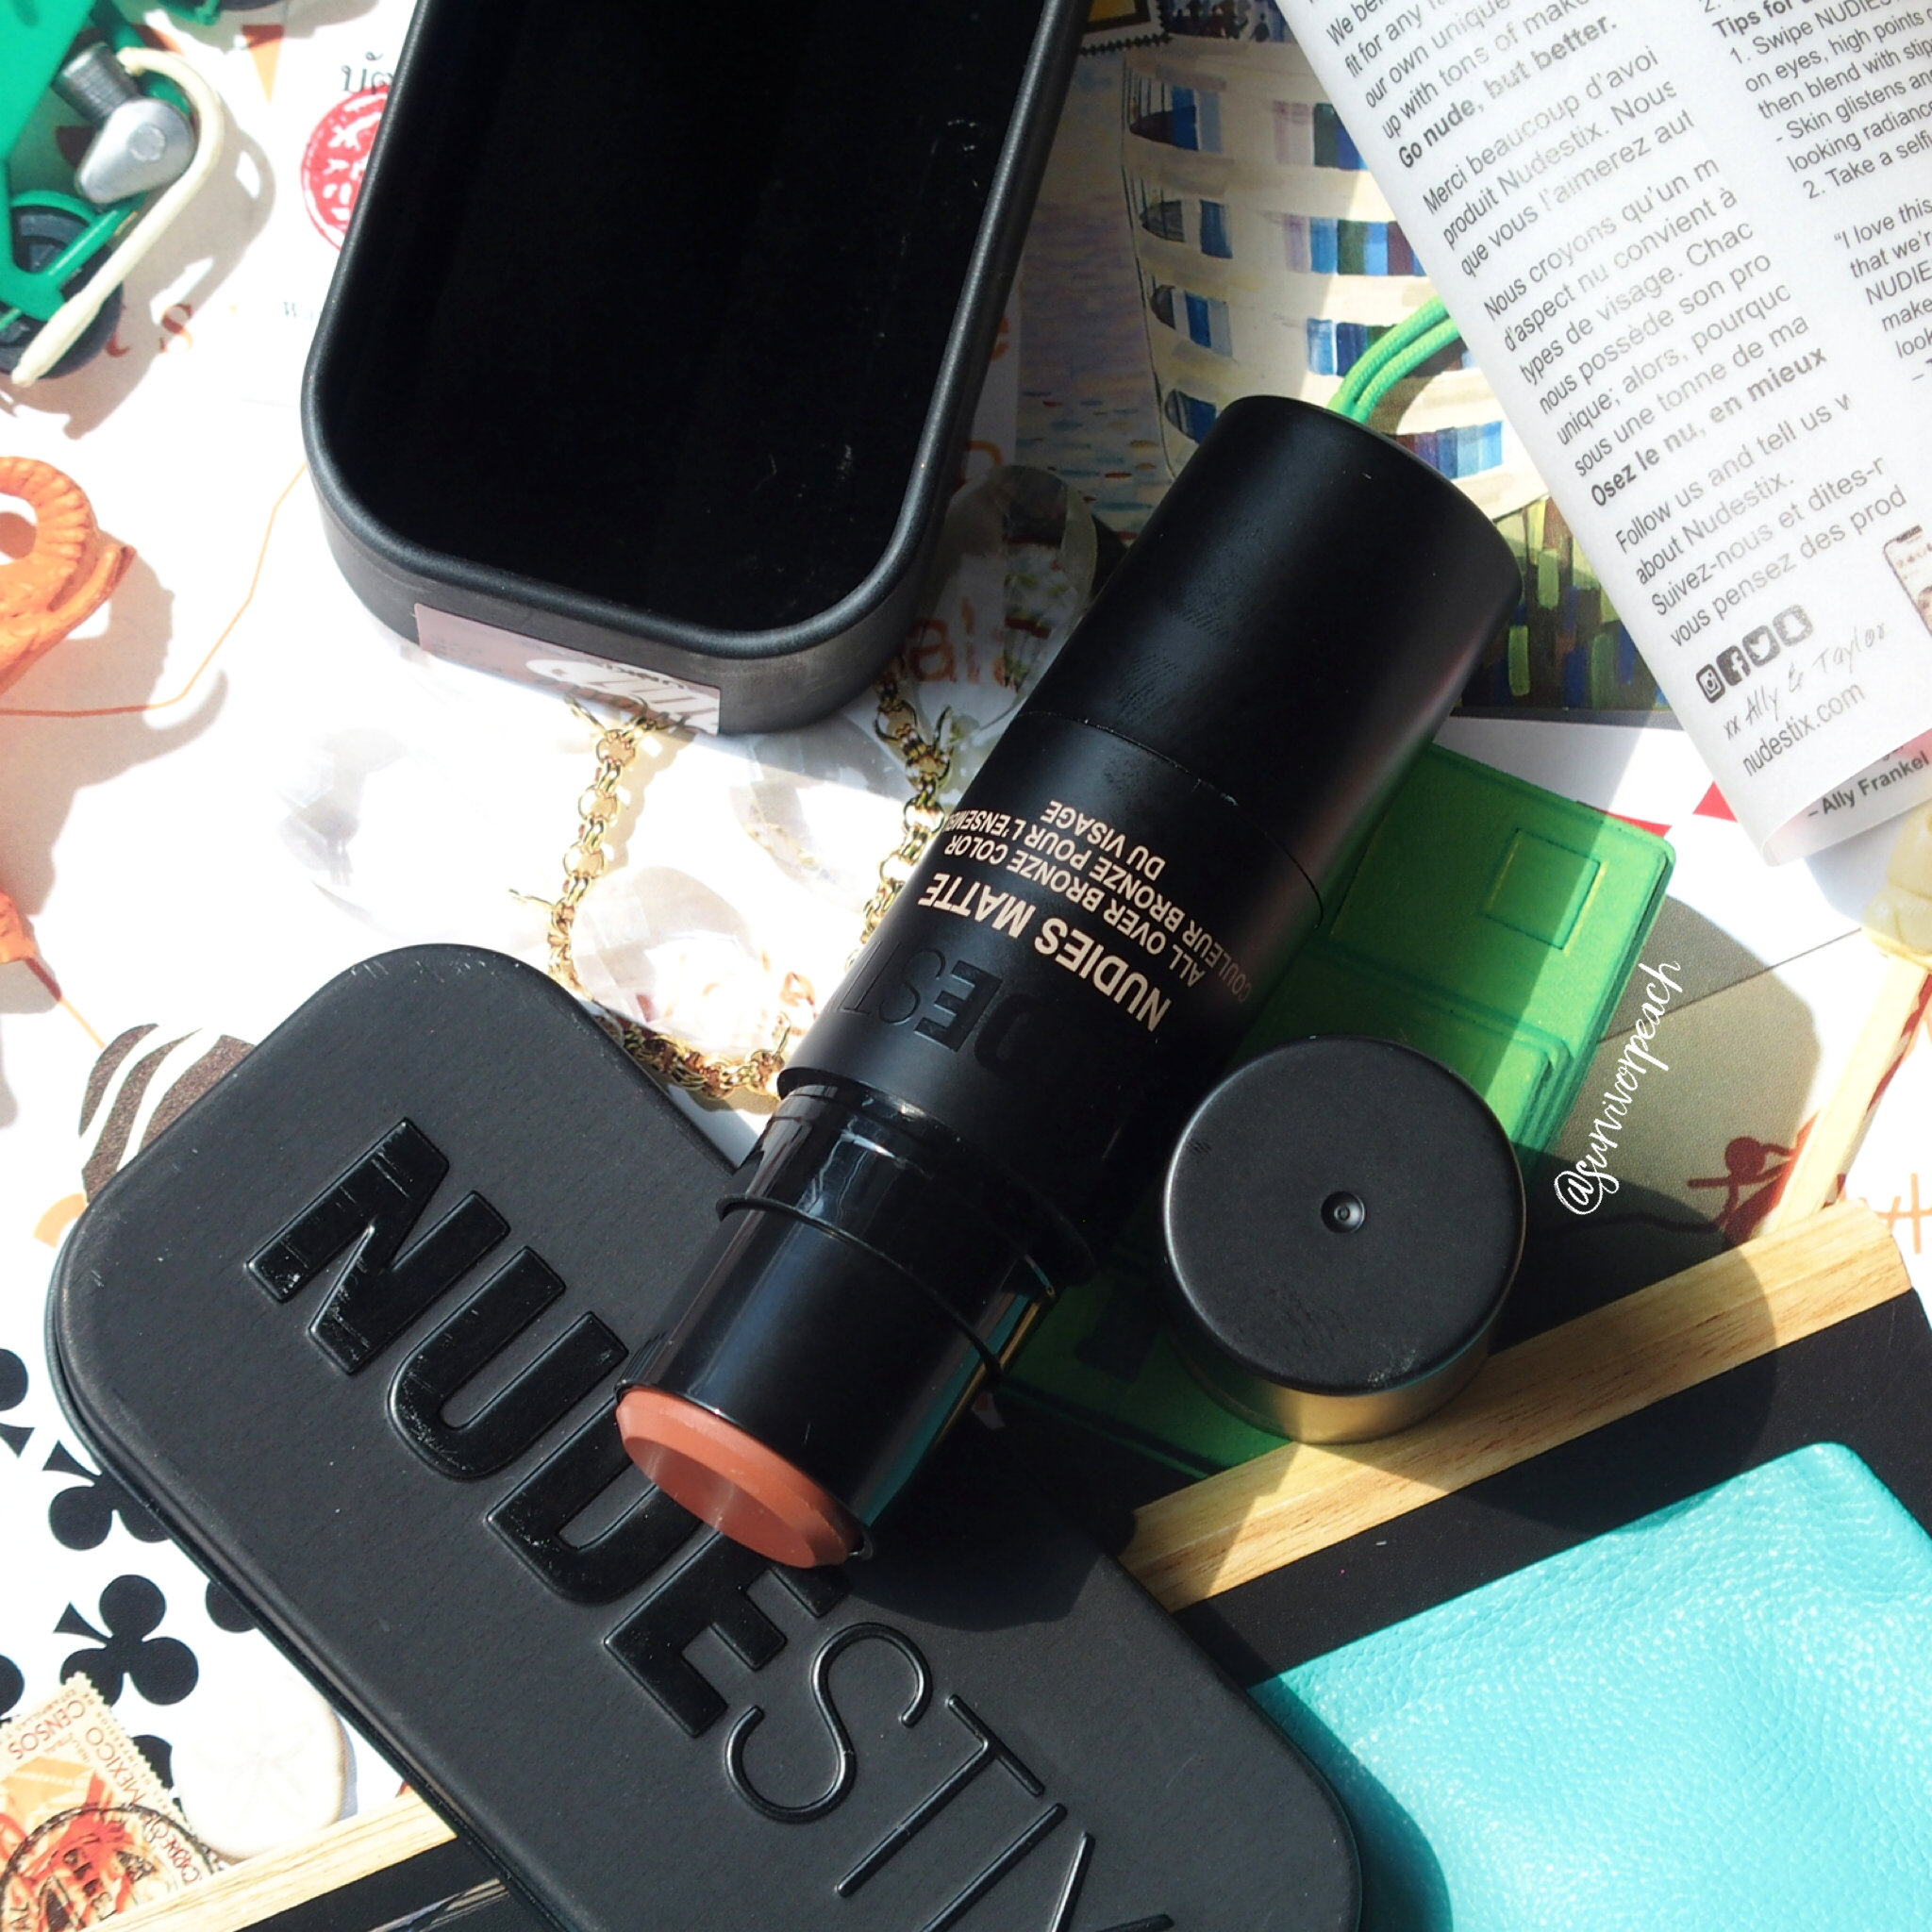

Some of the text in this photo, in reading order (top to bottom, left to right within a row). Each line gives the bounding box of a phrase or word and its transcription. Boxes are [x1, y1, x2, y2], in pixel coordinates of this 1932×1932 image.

[1325, 0, 1388, 46] We be
[1345, 4, 1422, 77] fit for any
[1711, 10, 1761, 38] Tips
[1745, 73, 1772, 92] on
[1775, 51, 1828, 79] eyes,
[1827, 28, 1872, 56] high
[1873, 8, 1924, 43] points
[1752, 22, 1813, 55] Swipe
[1365, 76, 1388, 108] our
[1389, 45, 1429, 84] own
[1382, 114, 1401, 140] up
[1399, 82, 1439, 120] with
[1439, 47, 1489, 87] tons
[1495, 22, 1518, 51] of
[1398, 142, 1423, 169] Go
[1483, 60, 1531, 99] but
[1530, 16, 1617, 71] better.
[1757, 39, 1932, 119] then blend with stip
[1786, 112, 1832, 139] Skin
[1836, 81, 1907, 124] glistens
[1423, 164, 1468, 215] Merci
[1466, 95, 1579, 175] beaucoup
[1443, 81, 1676, 251] produit Nudestix. Nous
[1787, 132, 1861, 173] looking
[1803, 180, 1825, 199] 2.
[1824, 159, 1875, 187] Take
[1879, 152, 1893, 167] a
[1461, 243, 1489, 278] que
[1488, 206, 1539, 247] vous
[1484, 277, 1527, 322] Nous
[1529, 217, 1616, 283] croyons
[1622, 176, 1690, 224] qu'un
[1853, 216, 1895, 244] love
[1898, 198, 1932, 224] this
[1505, 284, 1576, 352] d'aspect
[1577, 264, 1608, 292] nu
[1614, 198, 1717, 269] convient
[1850, 248, 1890, 278] that
[1865, 259, 1932, 306] NUDIE
[1519, 224, 1753, 387] types de visage. Chac
[1540, 255, 1771, 415] nous possède son pro
[1881, 298, 1932, 332] make
[1557, 388, 1621, 445] unique;
[1623, 349, 1688, 393] alors,
[1574, 316, 1808, 477] sous une tonne de ma
[1591, 348, 1827, 508] Osez le nu, en mieux
[1615, 501, 1672, 555] Follow
[1674, 482, 1704, 508] us
[1708, 444, 1755, 487] and
[1757, 420, 1796, 456] tell
[1800, 406, 1832, 431] us
[1636, 474, 1793, 586] about Nudestix.
[1652, 525, 1773, 616] Suivez-nous
[1778, 503, 1805, 528] et
[1670, 609, 1711, 646] vous
[1712, 553, 1796, 621] pensez
[1800, 525, 1845, 558] des
[1850, 484, 1907, 535] prod
[1742, 685, 1865, 776] nudestix.com
[1745, 684, 1780, 725] Ally
[1822, 789, 1857, 815] Ally
[1857, 751, 1930, 796] Frankel
[1025, 824, 1094, 870] POUR
[1041, 799, 1166, 881] DU VISAGE
[944, 835, 1206, 988] ALL OVER BRONZE COLOR
[1089, 855, 1186, 933] BRONZE
[918, 873, 1173, 1033] NUDIES MATTE
[1182, 919, 1253, 1004] COULEUR
[8, 1699, 85, 1760] CENSOS
[86, 1727, 147, 1806] MEXICO
